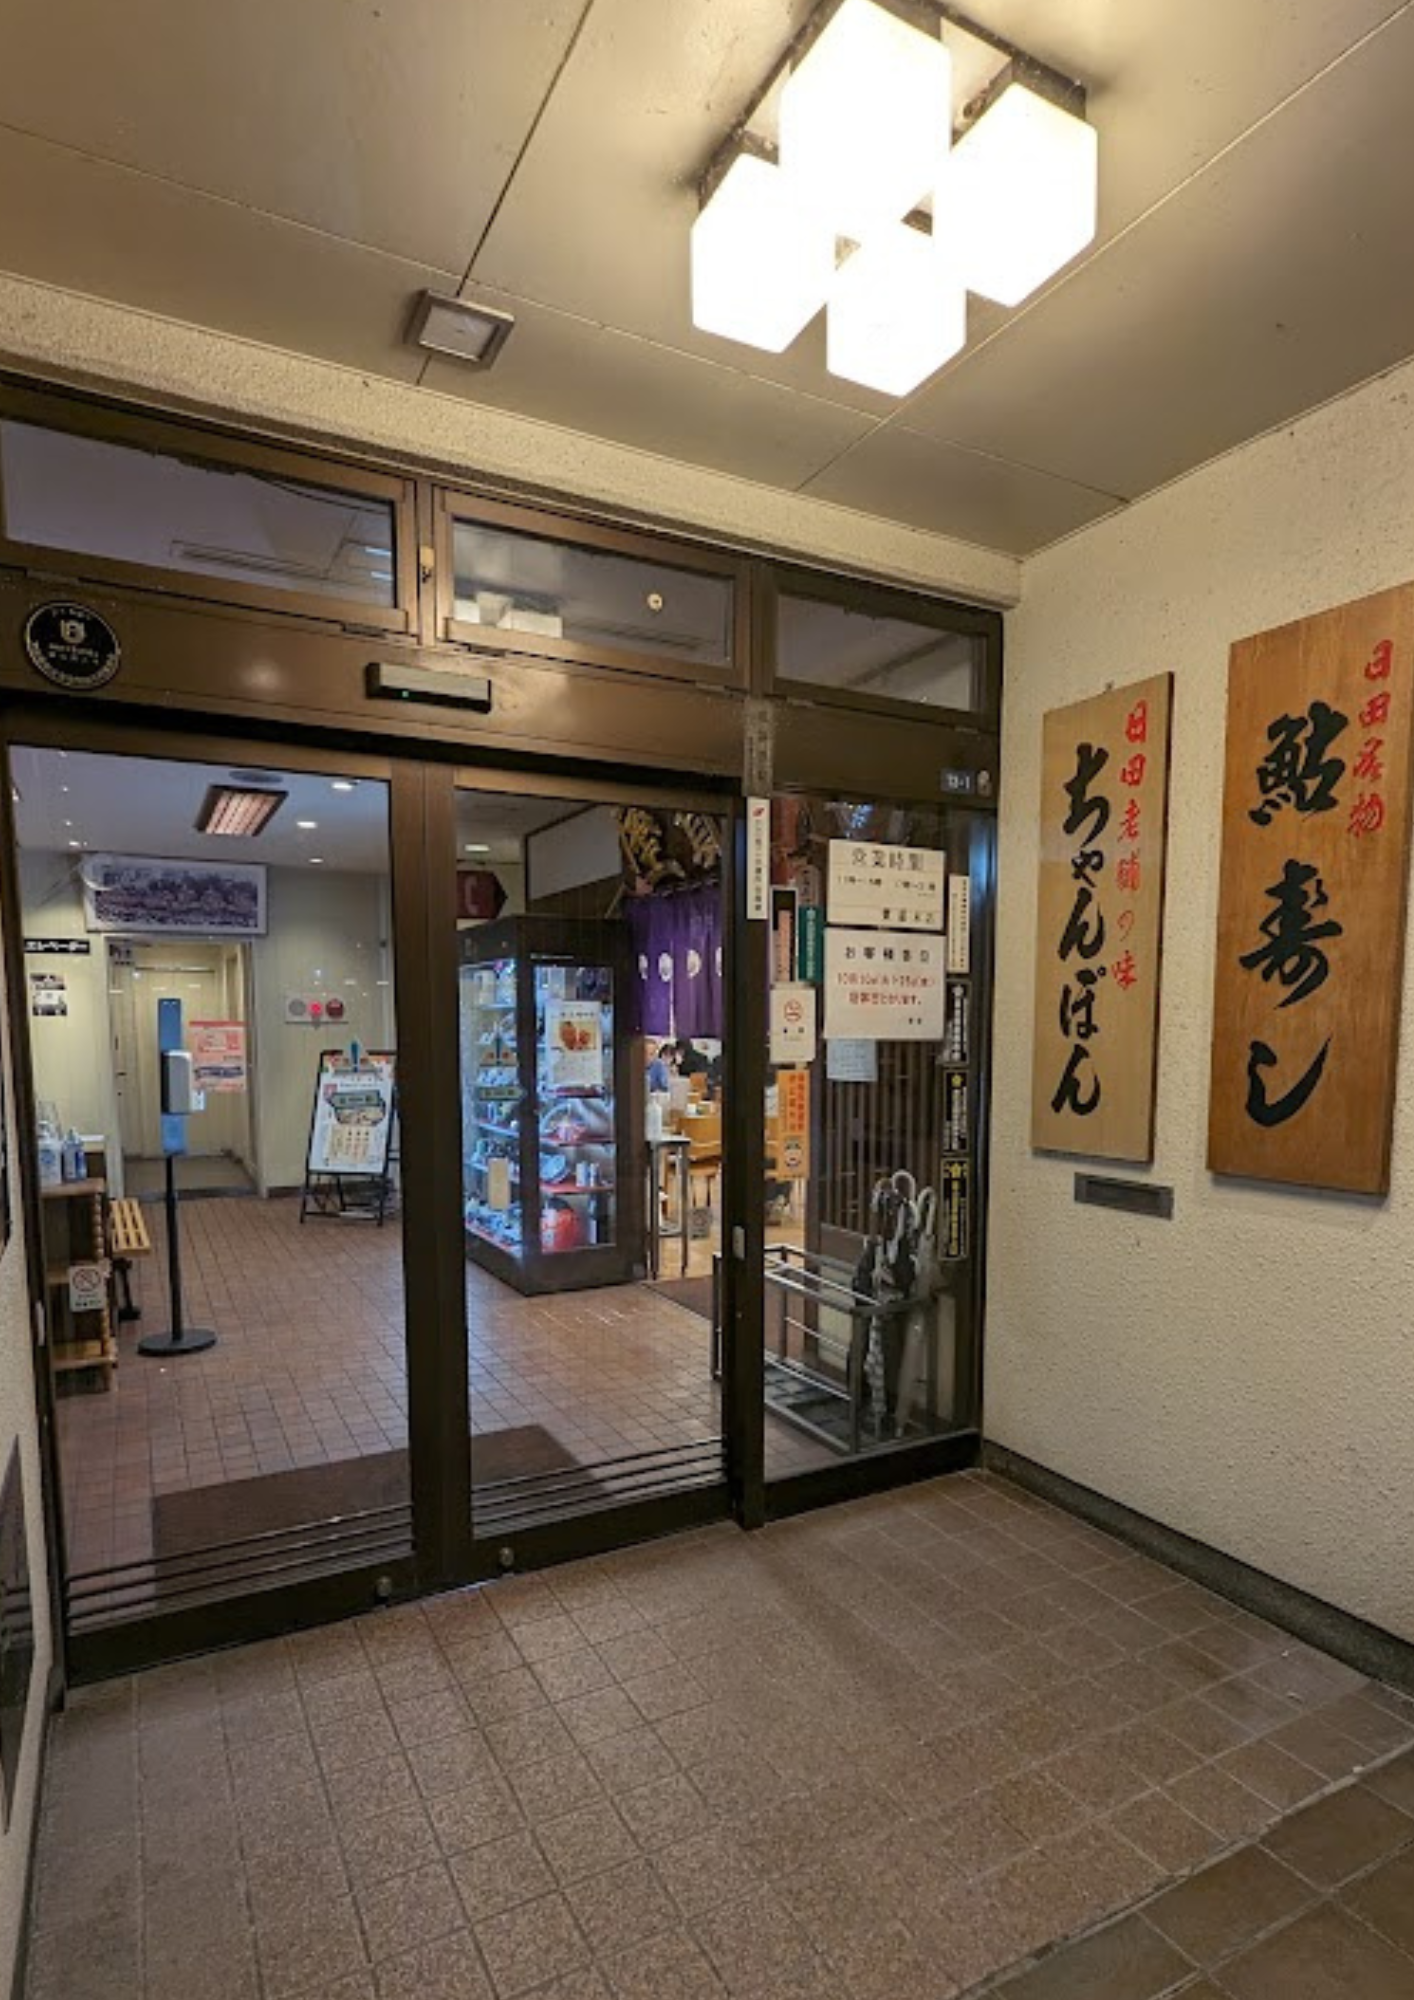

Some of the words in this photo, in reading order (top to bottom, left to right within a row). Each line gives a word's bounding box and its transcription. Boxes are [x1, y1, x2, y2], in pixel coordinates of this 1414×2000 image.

[1051, 742, 1110, 1116] ちゃんぽん
[1111, 700, 1149, 991] 日田老舗の味
